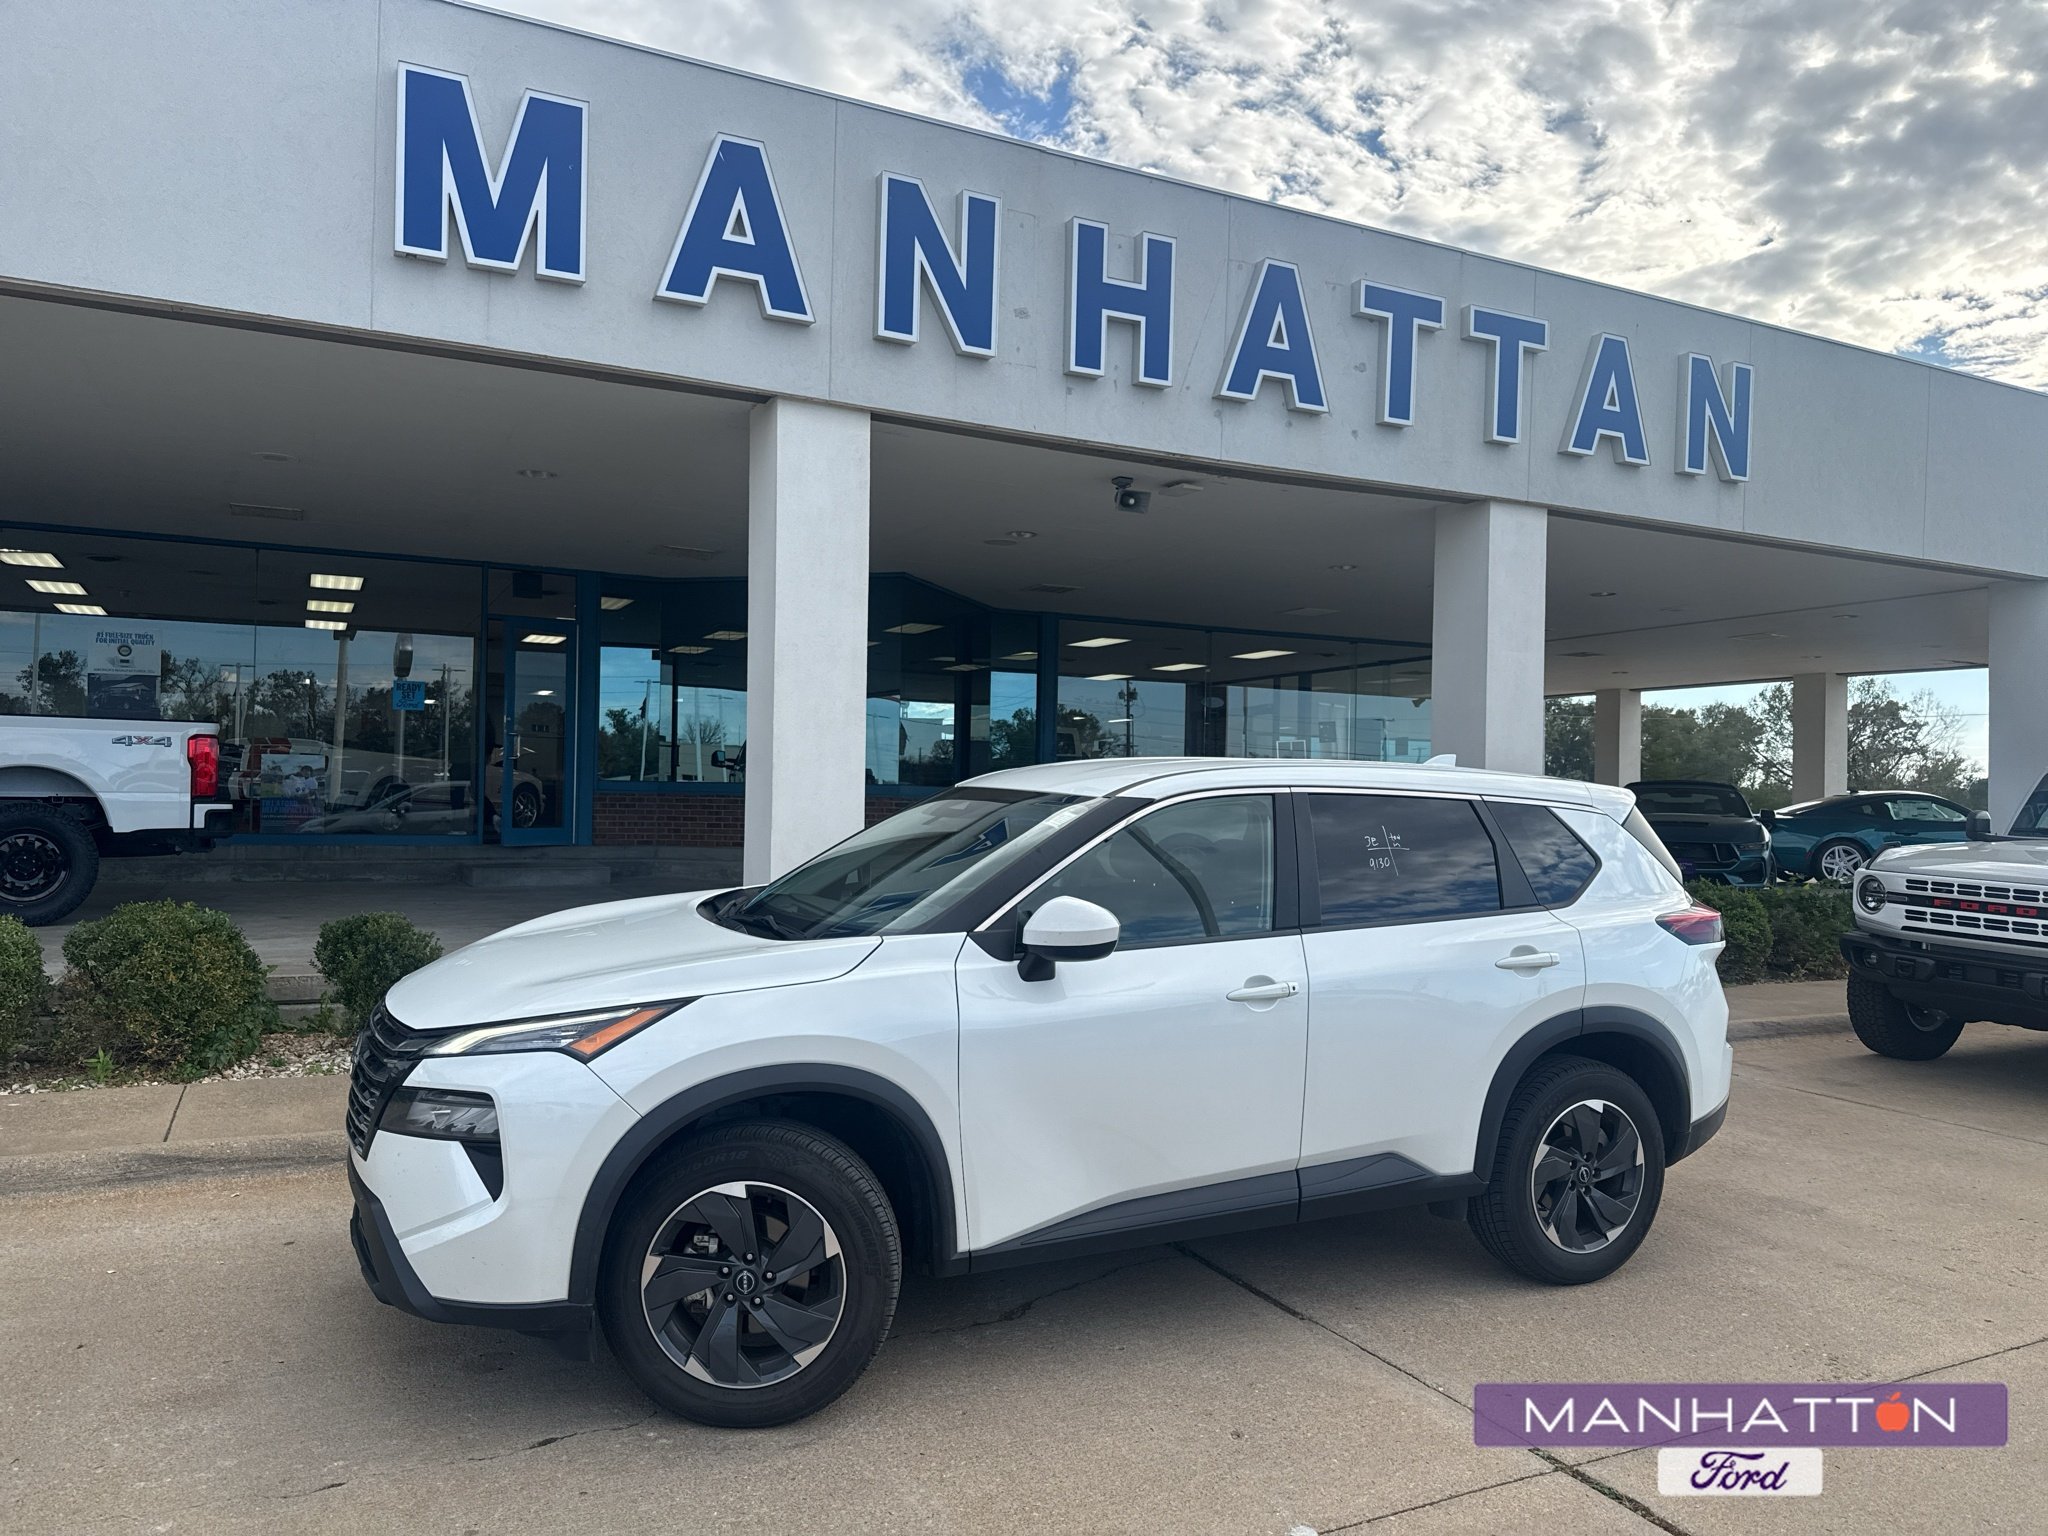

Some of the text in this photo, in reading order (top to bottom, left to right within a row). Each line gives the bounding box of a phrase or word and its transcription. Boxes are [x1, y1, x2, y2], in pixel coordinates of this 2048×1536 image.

[394, 59, 1755, 484] MANHATTAN
[396, 682, 422, 692] READY
[401, 691, 416, 699] SET
[1369, 857, 1390, 870] 9130
[1933, 898, 2038, 916] FORD
